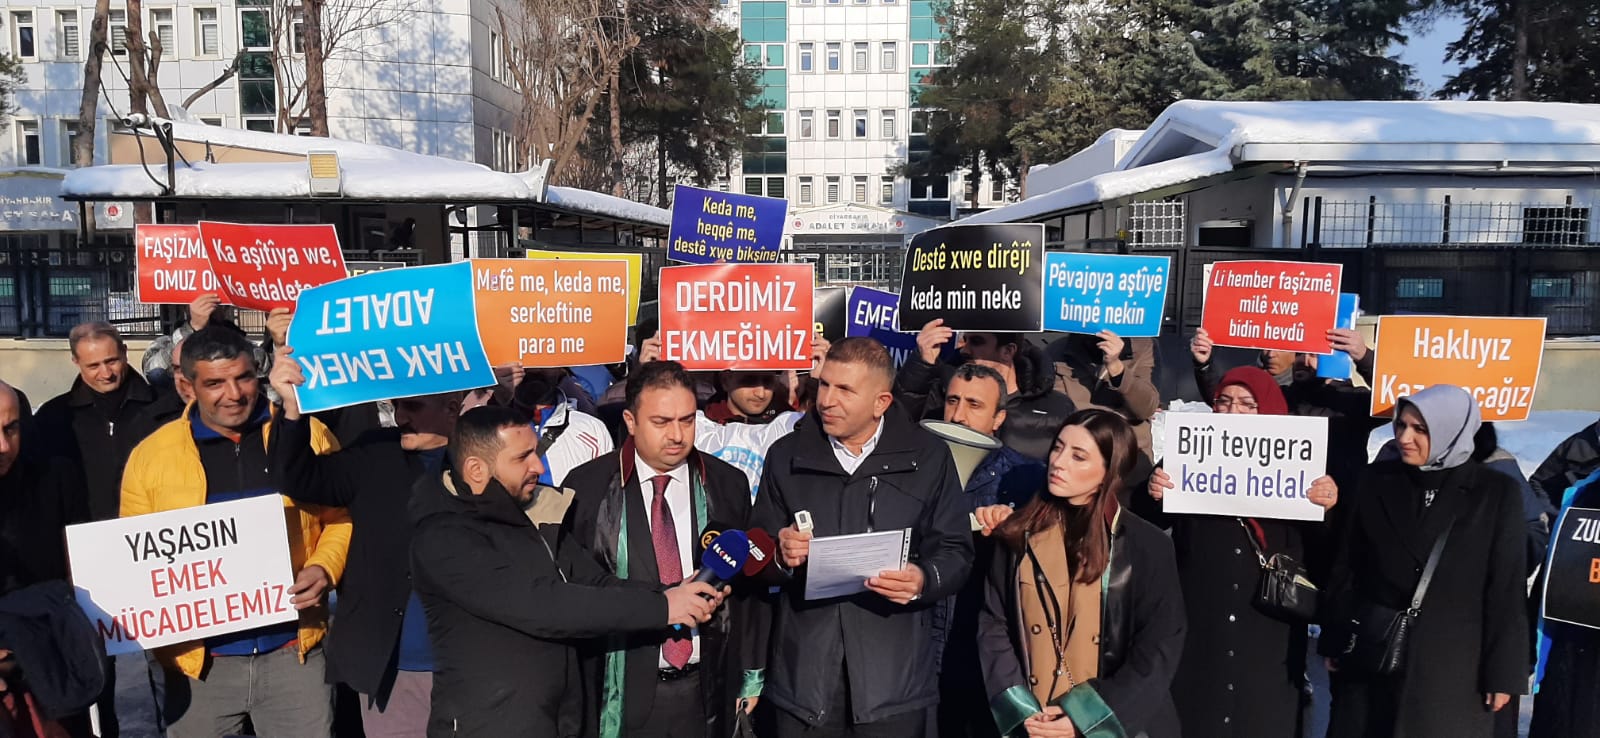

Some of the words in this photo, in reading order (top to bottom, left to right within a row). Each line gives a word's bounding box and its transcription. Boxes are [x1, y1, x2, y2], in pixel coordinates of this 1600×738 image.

[702, 197, 734, 216] Keda
[736, 204, 757, 221] me,
[697, 219, 733, 242] heqqê
[736, 226, 757, 243] me,
[809, 222, 845, 230] ADALET
[212, 238, 237, 264] Ka
[240, 239, 299, 272] aşîtîya
[302, 247, 337, 268] we,
[674, 235, 707, 254] destê
[709, 246, 733, 260] xwe
[912, 243, 947, 272] Destê
[949, 247, 982, 270] xwe
[987, 240, 1032, 276] dirêjî
[153, 270, 197, 291] OMUZ
[223, 274, 247, 299] Ka
[519, 274, 549, 296] me,
[553, 270, 593, 293] keda
[596, 274, 626, 297] me,
[675, 273, 796, 312] DERDİMİZ
[1048, 262, 1115, 296] Pêvajoya
[1118, 267, 1163, 295] aştîyê
[1213, 269, 1226, 287] Li
[1227, 271, 1276, 290] hember
[1278, 271, 1336, 297] faşîzmê,
[316, 288, 435, 335] ADALET
[510, 301, 593, 324] serkeftine
[910, 285, 943, 312] keda
[946, 283, 977, 310] min
[981, 284, 1022, 311] neke
[1060, 296, 1101, 327] binpê
[1104, 301, 1145, 326] nekin
[1239, 295, 1268, 314] milê
[1272, 300, 1299, 316] xwe
[665, 321, 807, 361] EKMEĞİMİZ
[1229, 318, 1260, 339] bidin
[1263, 321, 1305, 342] hevdû
[396, 341, 471, 378] HAK
[518, 337, 556, 360] para
[560, 337, 584, 354] me
[1413, 327, 1512, 369] Haklıyız
[299, 348, 393, 389] EMEK
[1178, 425, 1215, 459] Bijî
[1220, 433, 1313, 466] tevgera
[1181, 464, 1237, 495] keda
[1246, 467, 1306, 499] helal
[124, 517, 239, 564] YAŞASIN
[150, 557, 228, 598] EMEK
[97, 581, 287, 643] MÜCADELEMİZ
